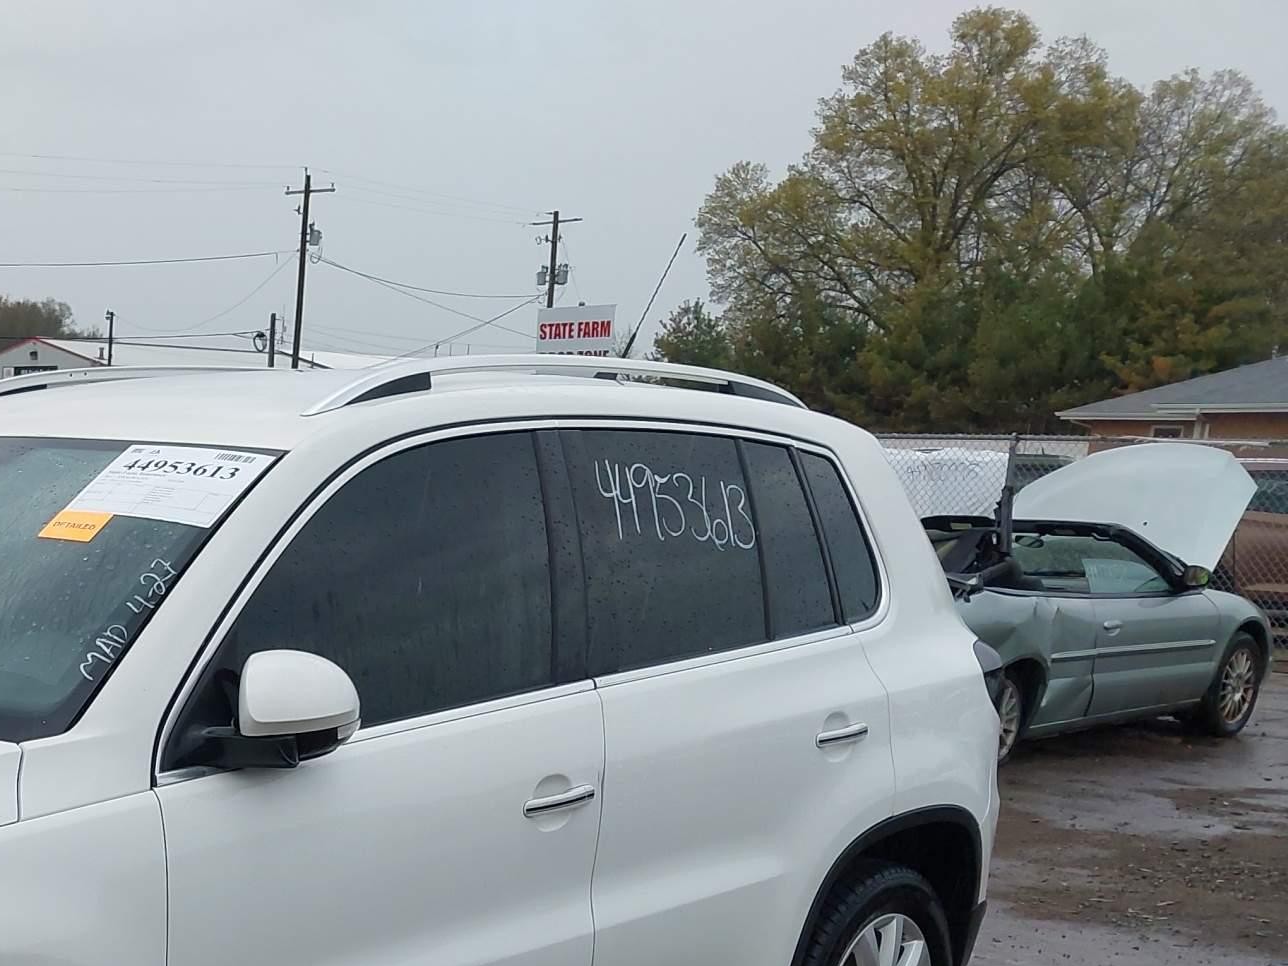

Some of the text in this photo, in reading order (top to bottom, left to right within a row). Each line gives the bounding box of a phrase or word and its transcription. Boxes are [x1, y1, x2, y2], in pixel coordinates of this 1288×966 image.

[539, 320, 612, 340] STATE FARM
[123, 458, 241, 480] 44953613
[594, 459, 756, 552] 44953613
[79, 624, 128, 681] MAD
[125, 558, 178, 614] 4-27
